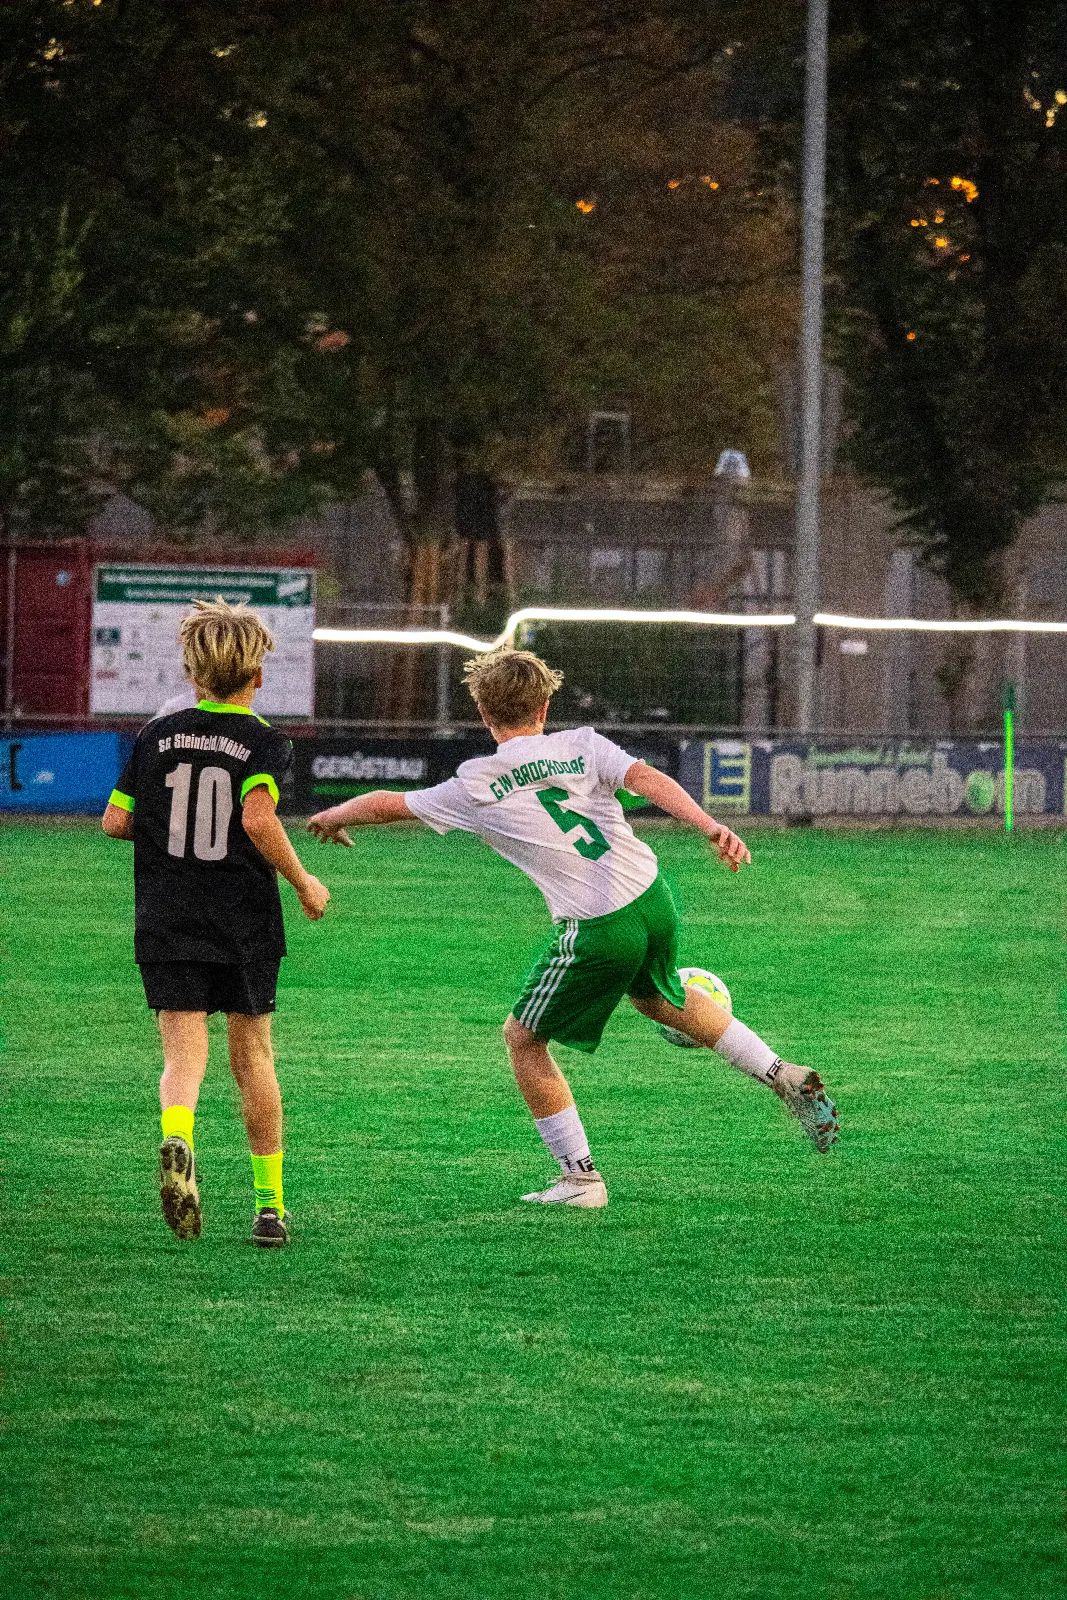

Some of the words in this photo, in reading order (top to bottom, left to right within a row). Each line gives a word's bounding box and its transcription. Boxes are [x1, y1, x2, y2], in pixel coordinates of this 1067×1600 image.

[158, 737, 171, 753] SG
[511, 755, 585, 787] BROCKDORF
[165, 762, 233, 861] 10
[535, 786, 612, 861] 5
